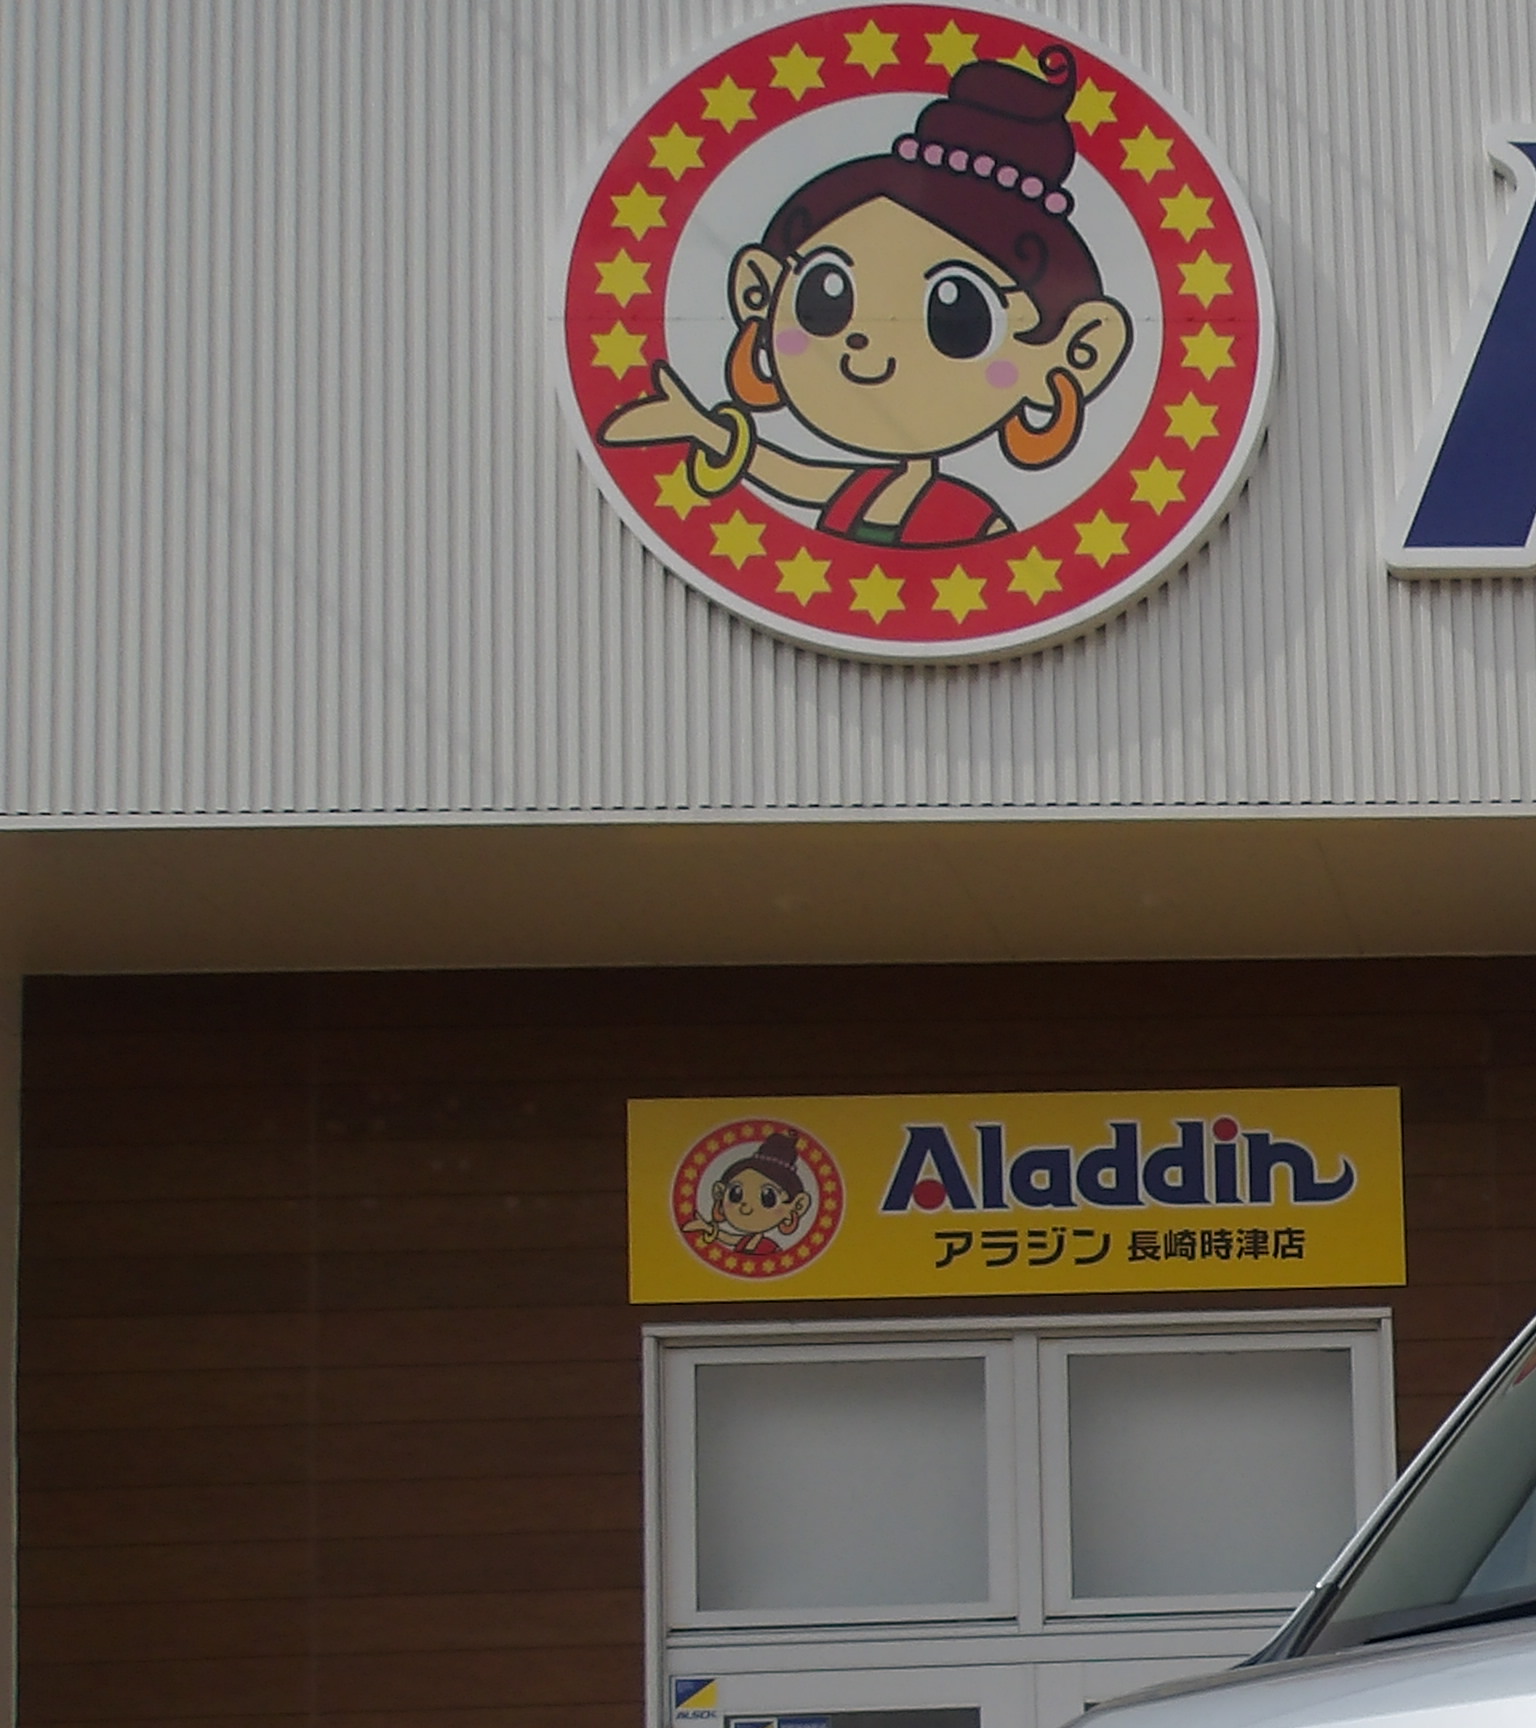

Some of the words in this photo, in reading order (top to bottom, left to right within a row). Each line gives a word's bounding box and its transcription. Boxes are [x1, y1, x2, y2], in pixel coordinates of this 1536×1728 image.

[880, 1116, 1355, 1211] Aladdin
[934, 1228, 1111, 1269] アラジン
[1127, 1227, 1305, 1263] 長崎時津店
[676, 1710, 716, 1720] ALSOK
